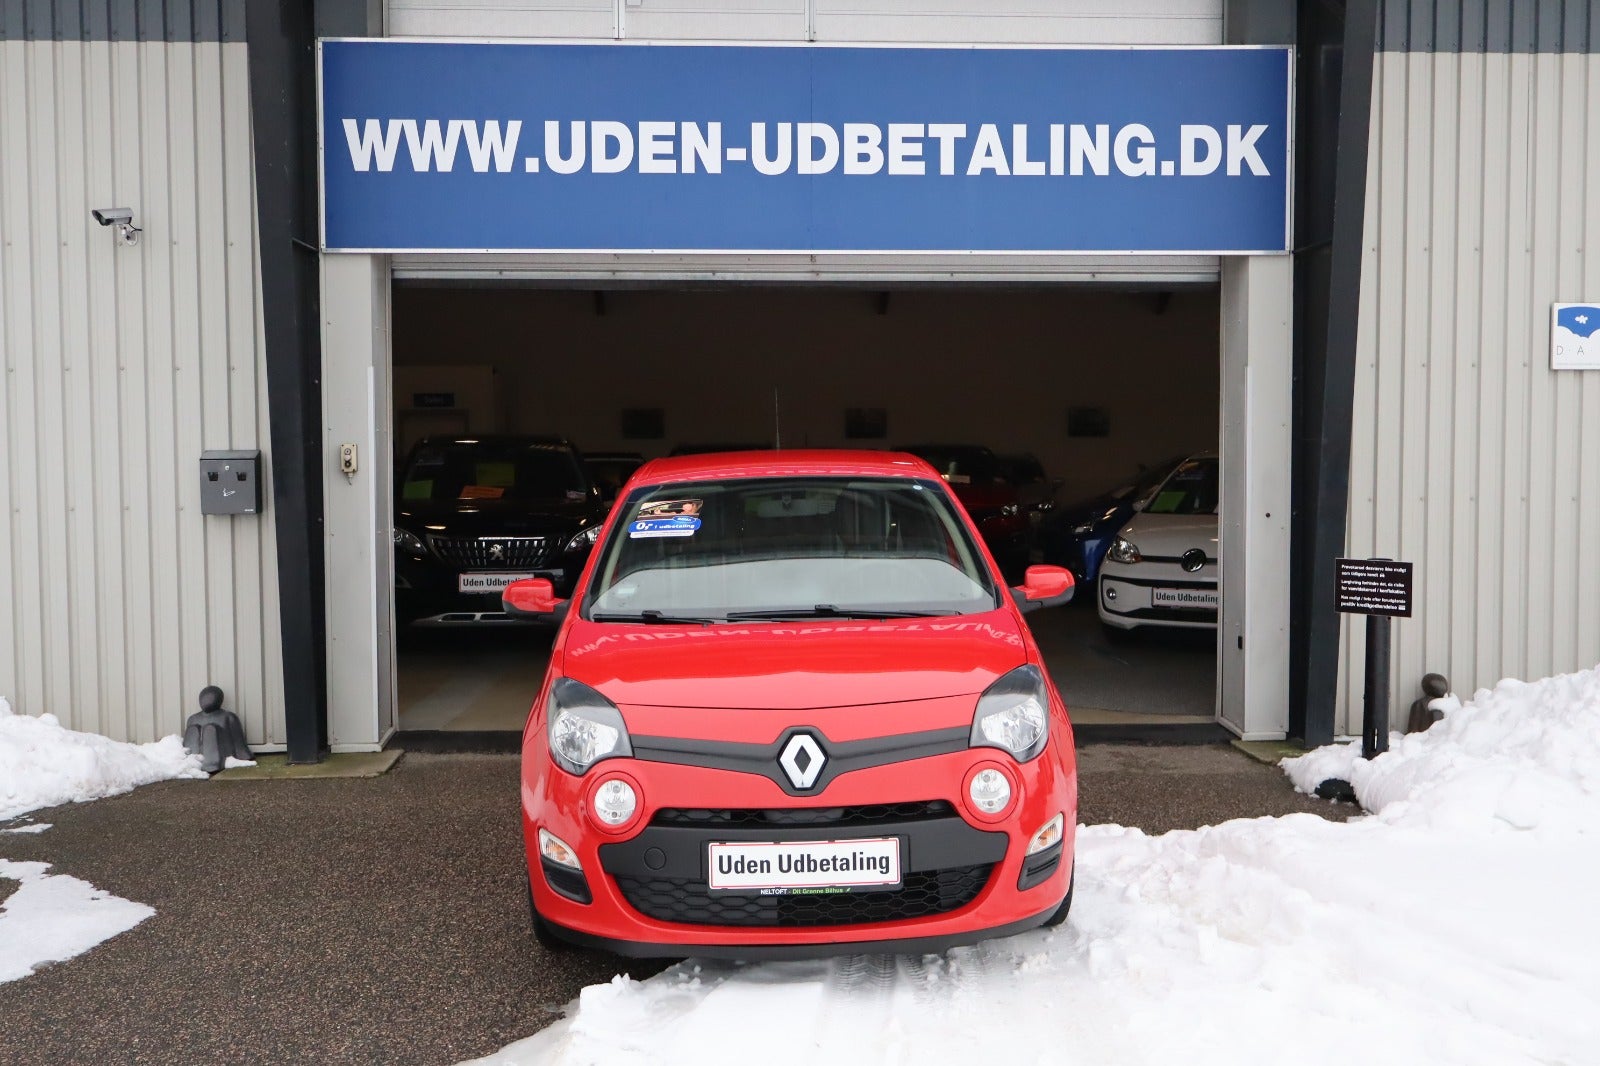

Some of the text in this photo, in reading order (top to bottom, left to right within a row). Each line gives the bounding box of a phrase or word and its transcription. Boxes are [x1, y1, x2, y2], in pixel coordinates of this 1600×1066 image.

[342, 119, 1270, 177] WWW.UDEN-UDBETALING.DK
[463, 578, 484, 586] Uden
[1156, 592, 1176, 600] Uden
[719, 852, 890, 875] Uden Udbetaling
